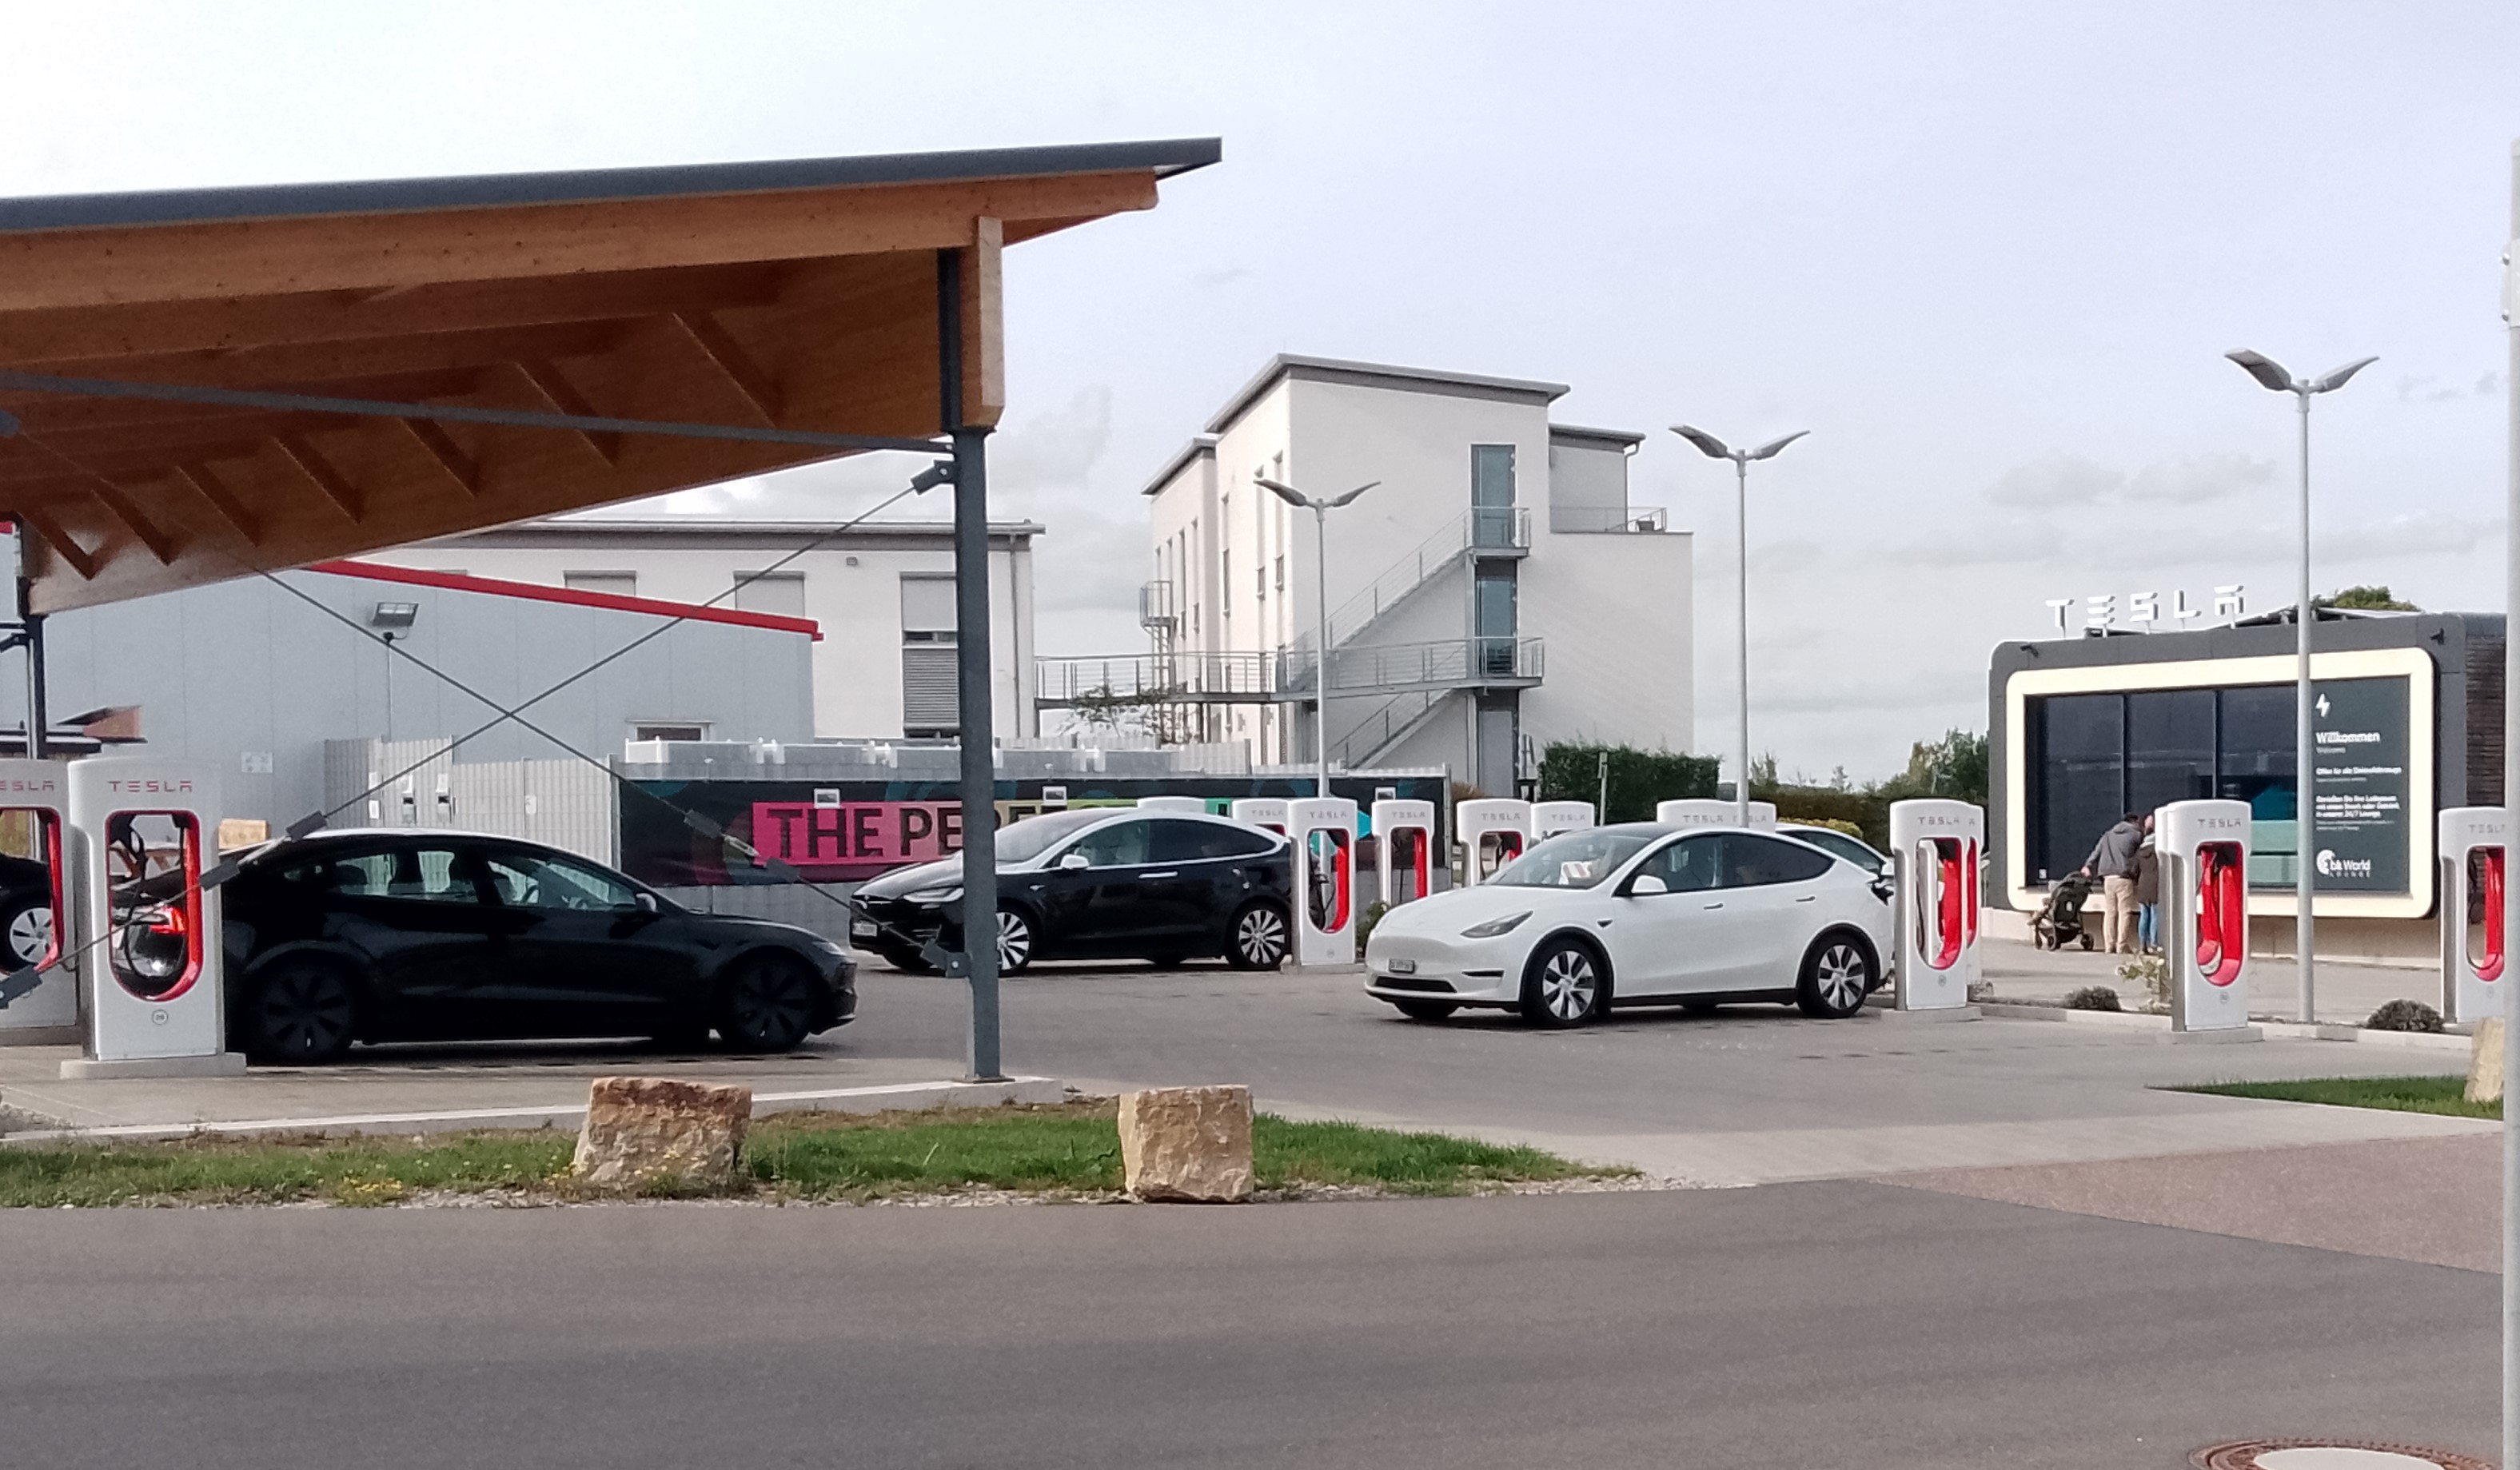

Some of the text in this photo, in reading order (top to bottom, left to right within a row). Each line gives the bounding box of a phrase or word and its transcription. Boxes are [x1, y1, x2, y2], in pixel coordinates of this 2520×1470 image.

[2045, 585, 2243, 627] TESLA
[0, 780, 54, 791] ESLA
[108, 780, 192, 792] TESLA
[1918, 816, 1960, 825] TESLA
[2197, 818, 2241, 828] TESLA
[768, 807, 883, 858] THE
[2343, 858, 2371, 871] World
